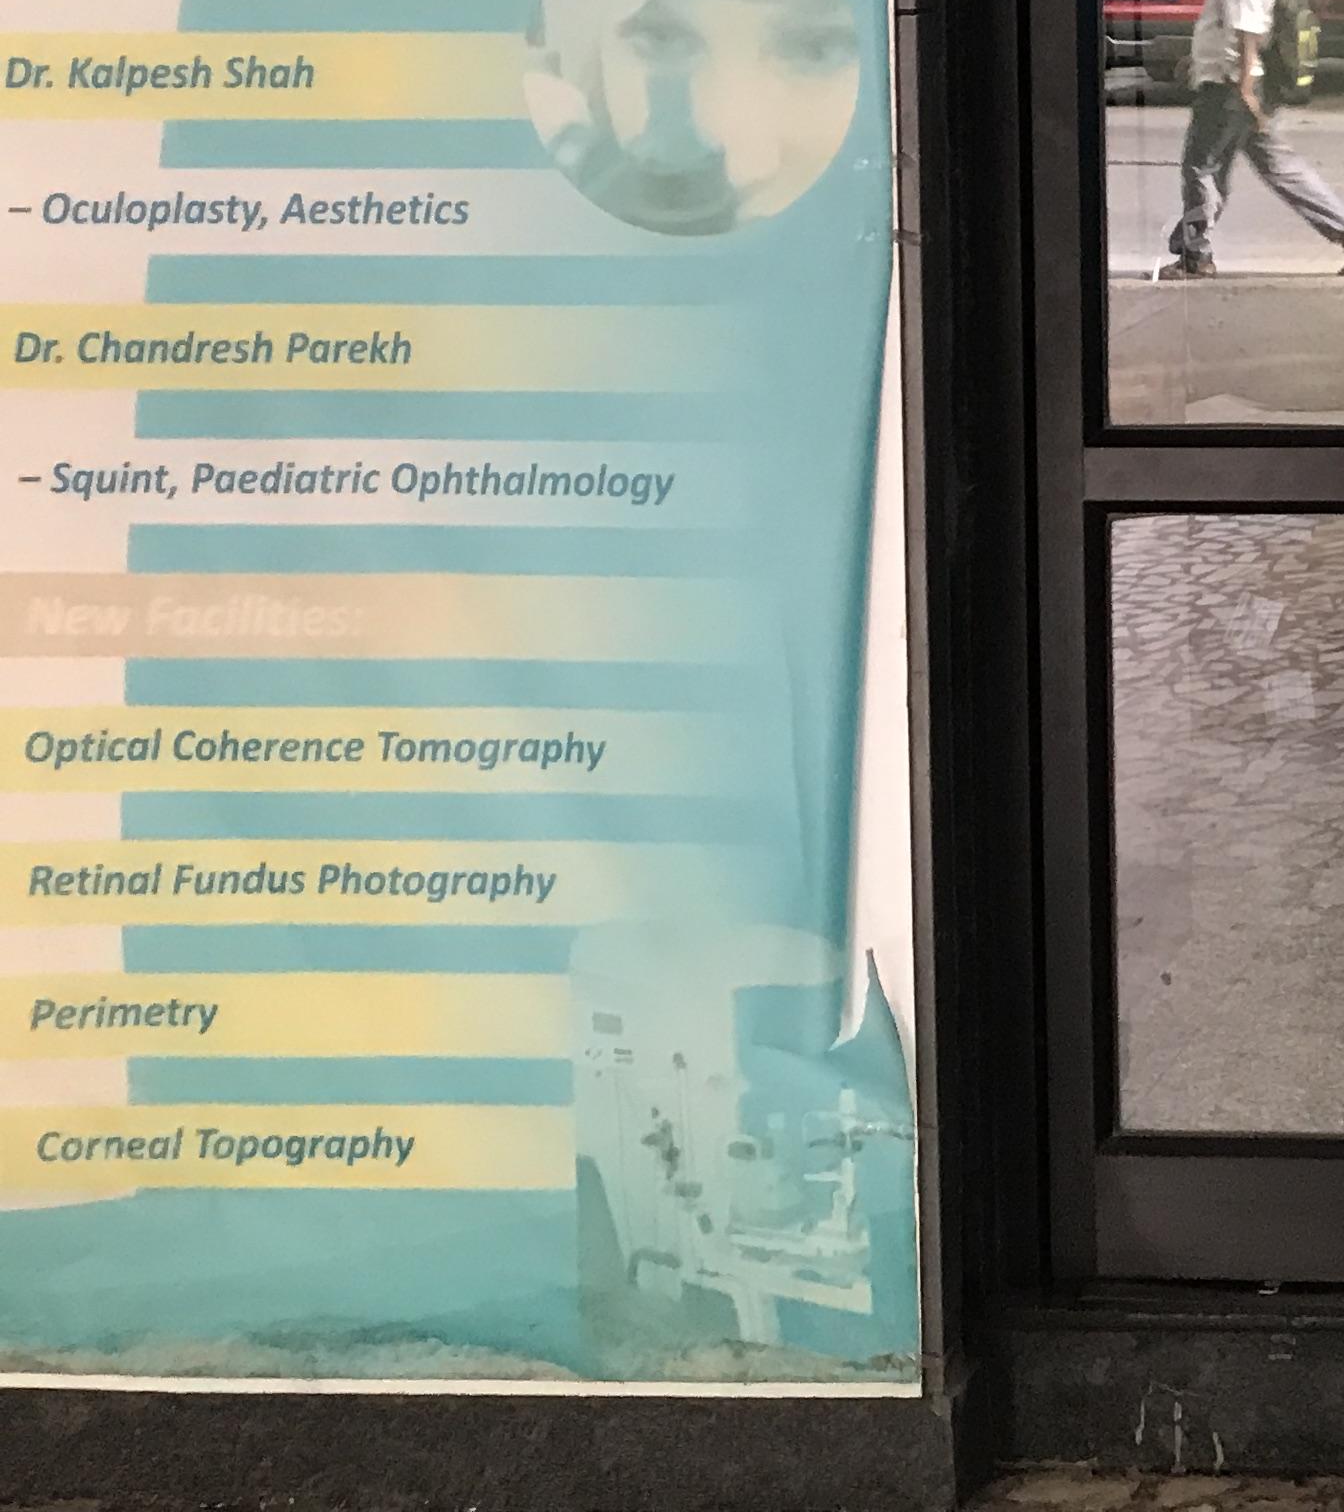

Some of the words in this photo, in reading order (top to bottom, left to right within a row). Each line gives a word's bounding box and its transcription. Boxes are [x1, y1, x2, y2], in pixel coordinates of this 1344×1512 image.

[5, 56, 54, 89] Dr.
[67, 56, 212, 97] Kalpesh
[223, 56, 315, 90] Shah
[42, 191, 269, 232] Oculoplasty,
[280, 191, 470, 226] Aesthetics
[14, 332, 65, 365] Dr.
[77, 331, 273, 366] Chandresh
[286, 331, 412, 366] Parekh
[50, 462, 177, 501] Squint,
[191, 463, 380, 497] Paediatric
[390, 464, 676, 506] Ophthalmology
[25, 597, 128, 637] New
[24, 728, 163, 767] Optical
[172, 729, 365, 764] Coherence
[379, 731, 607, 772] Tomography
[28, 863, 163, 897] Retinal
[173, 863, 306, 897] Fundus
[318, 865, 557, 904] Photography
[30, 997, 219, 1034] Perimetry
[37, 1129, 183, 1164] Corneal
[195, 1129, 416, 1170] Topography
